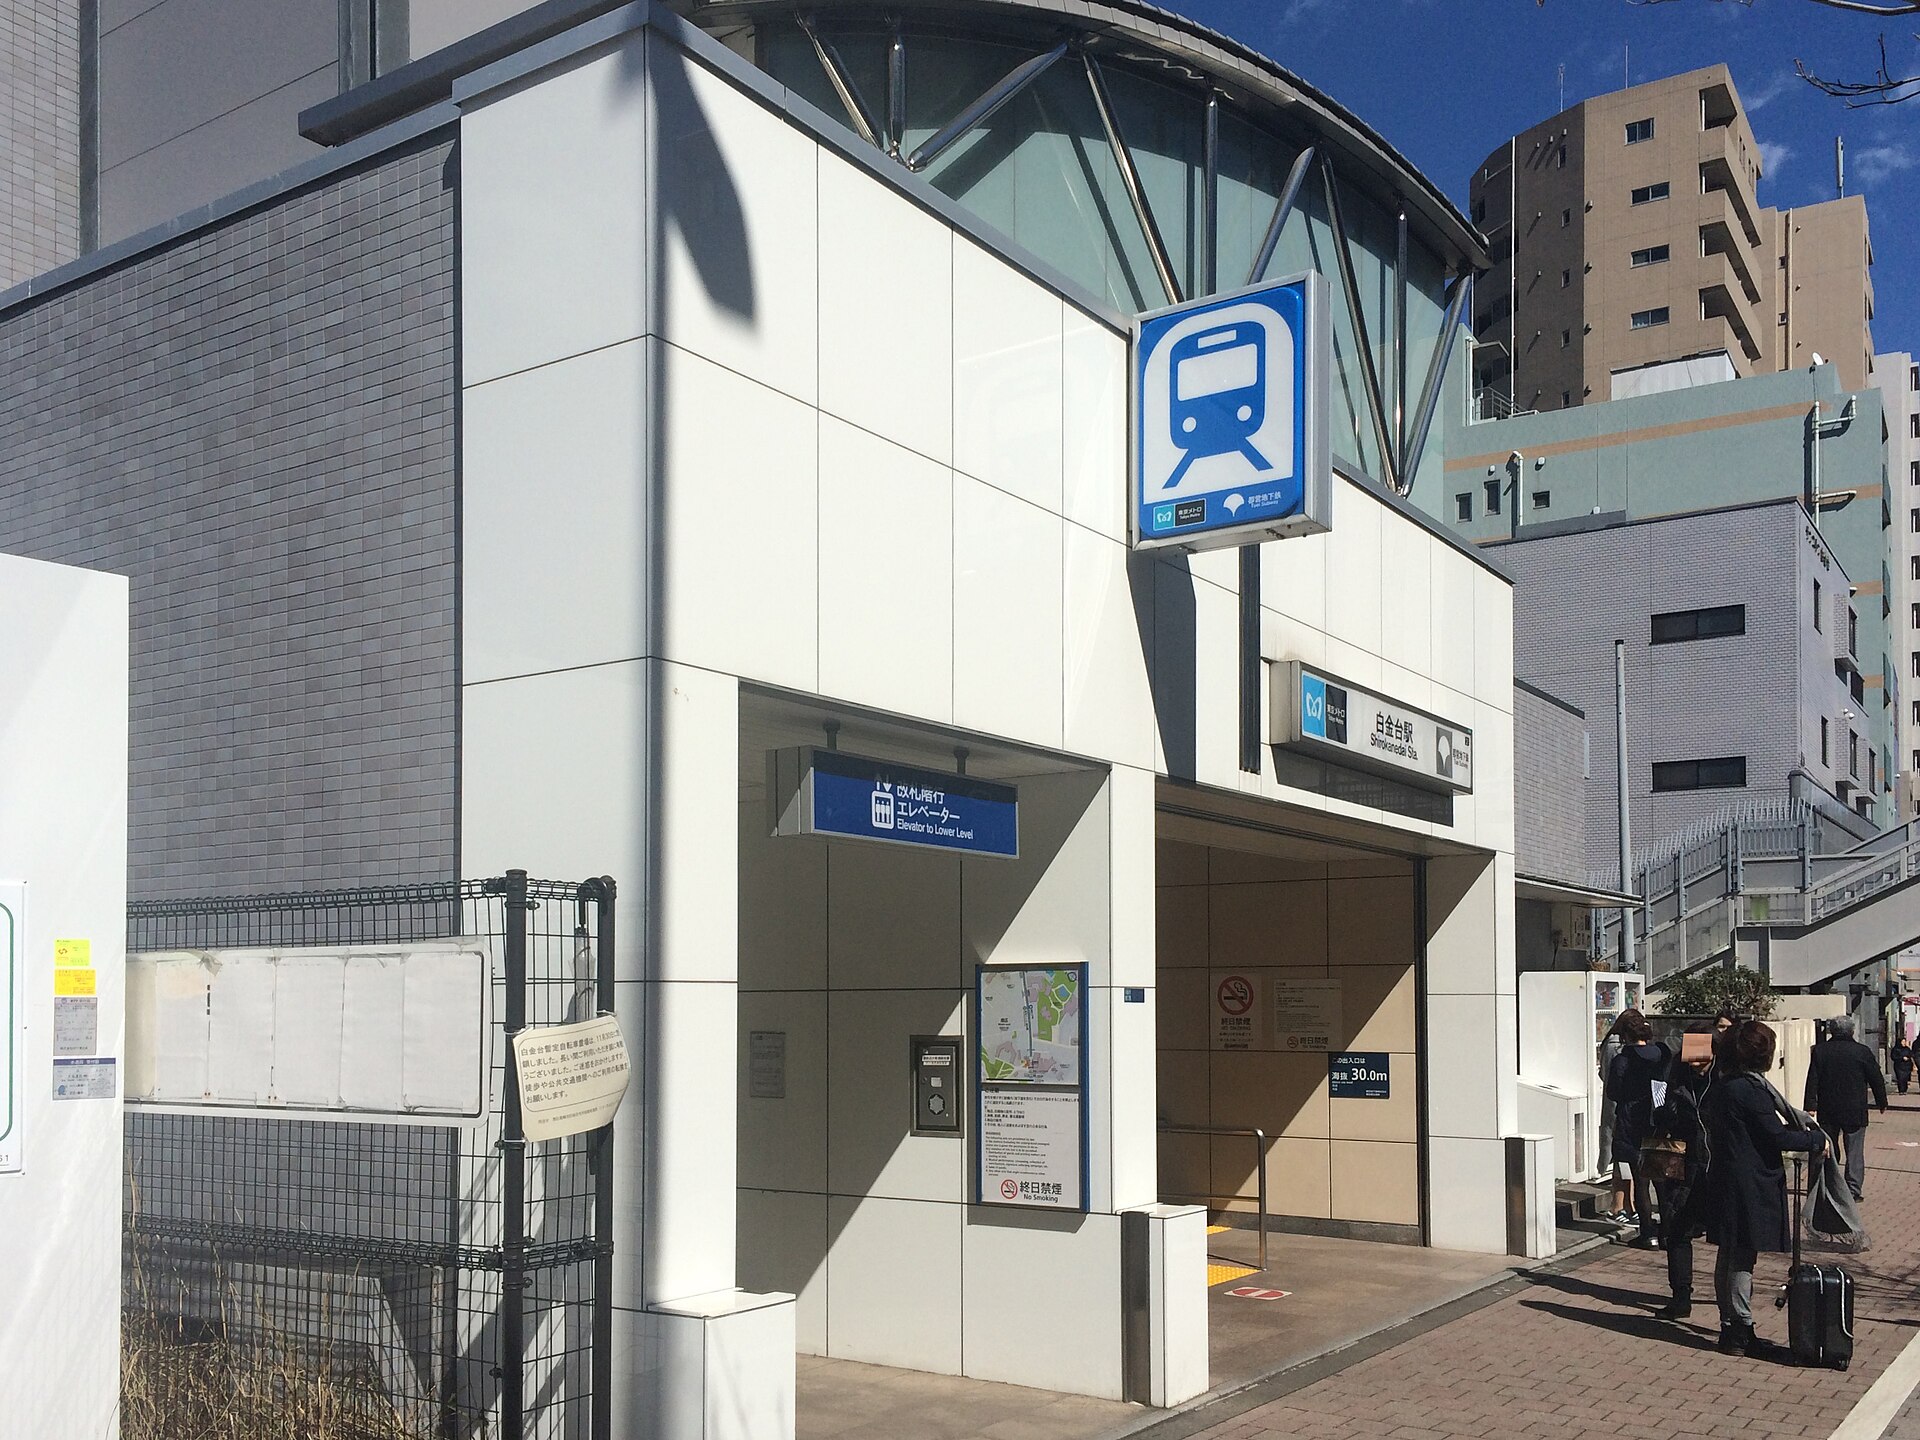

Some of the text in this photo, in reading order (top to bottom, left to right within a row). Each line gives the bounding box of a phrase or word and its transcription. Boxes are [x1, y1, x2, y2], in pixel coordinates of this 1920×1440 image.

[1178, 506, 1202, 515] 東京メトロ
[1376, 711, 1414, 744] 白金台駅
[1370, 732, 1407, 758] Shirokanedai
[896, 784, 945, 804] 改札階行
[897, 801, 960, 824] エレベーター
[897, 818, 974, 839] Elevator to Lower Level
[1332, 1068, 1387, 1081] 海抜 30.0m
[1020, 1181, 1062, 1195] 終日禁煙
[1033, 1194, 1058, 1203] Smoking
